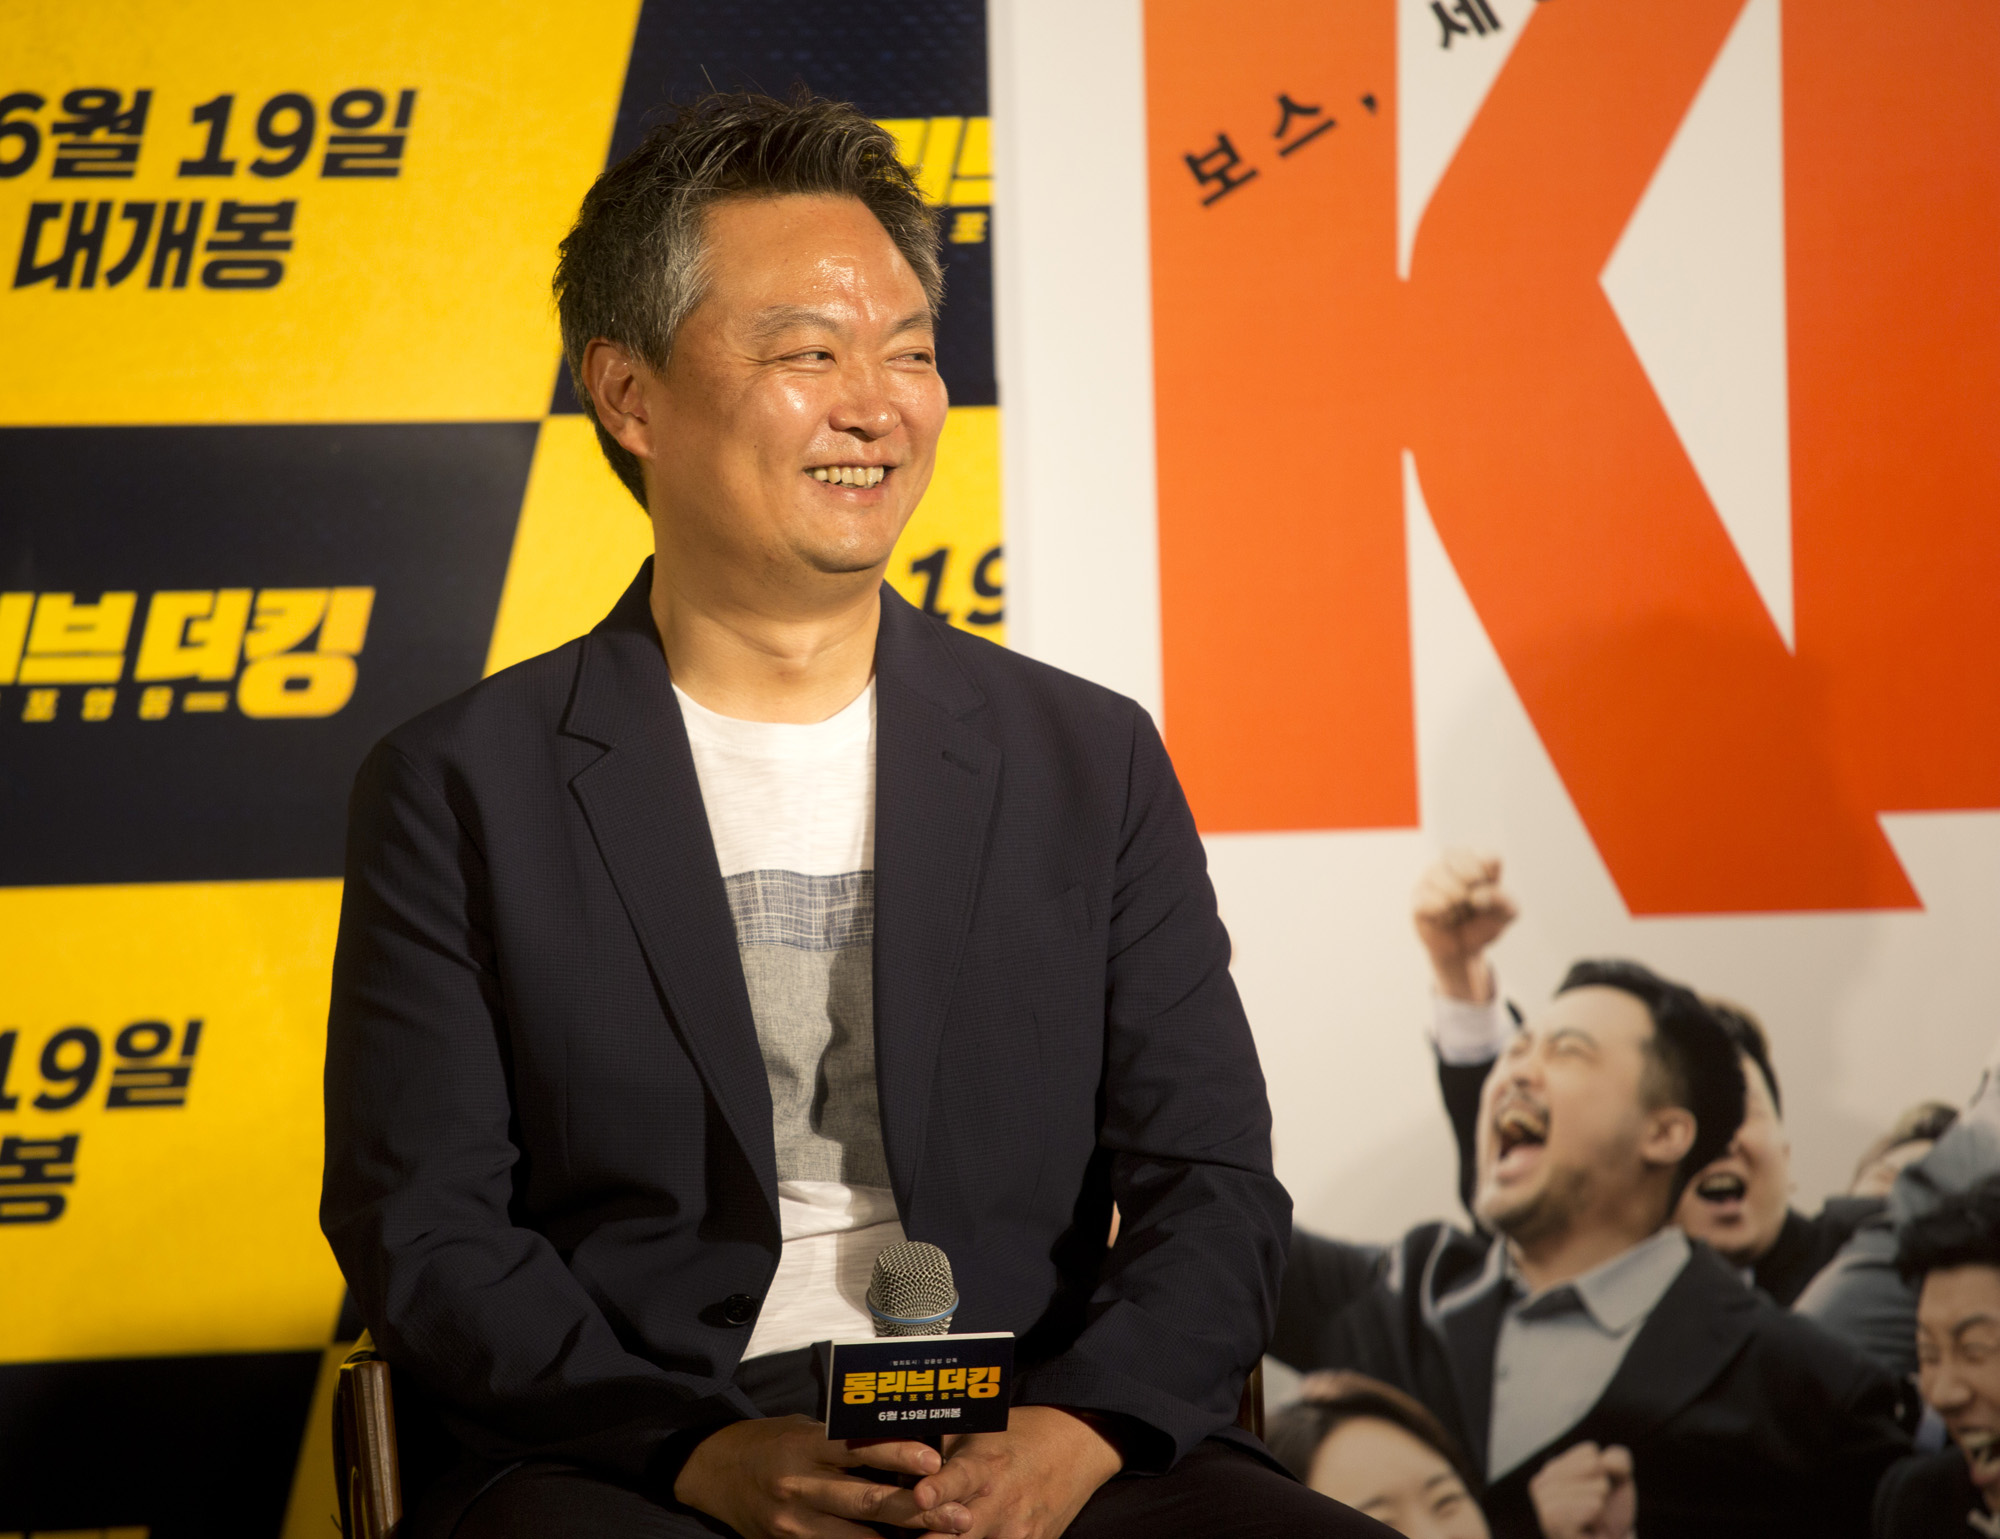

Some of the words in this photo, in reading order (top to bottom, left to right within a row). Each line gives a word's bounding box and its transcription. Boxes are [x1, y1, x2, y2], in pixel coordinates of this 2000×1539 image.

[0, 87, 154, 180] 6월
[176, 88, 419, 180] 19일
[12, 199, 298, 290] 대개봉
[133, 585, 376, 719] 더킹
[0, 1132, 81, 1227] 봉
[842, 1370, 935, 1405] 롱리브
[937, 1366, 1002, 1399] 더킹
[877, 1410, 898, 1422] 6월
[900, 1409, 928, 1421] 19일
[929, 1407, 962, 1419] 대개봉
